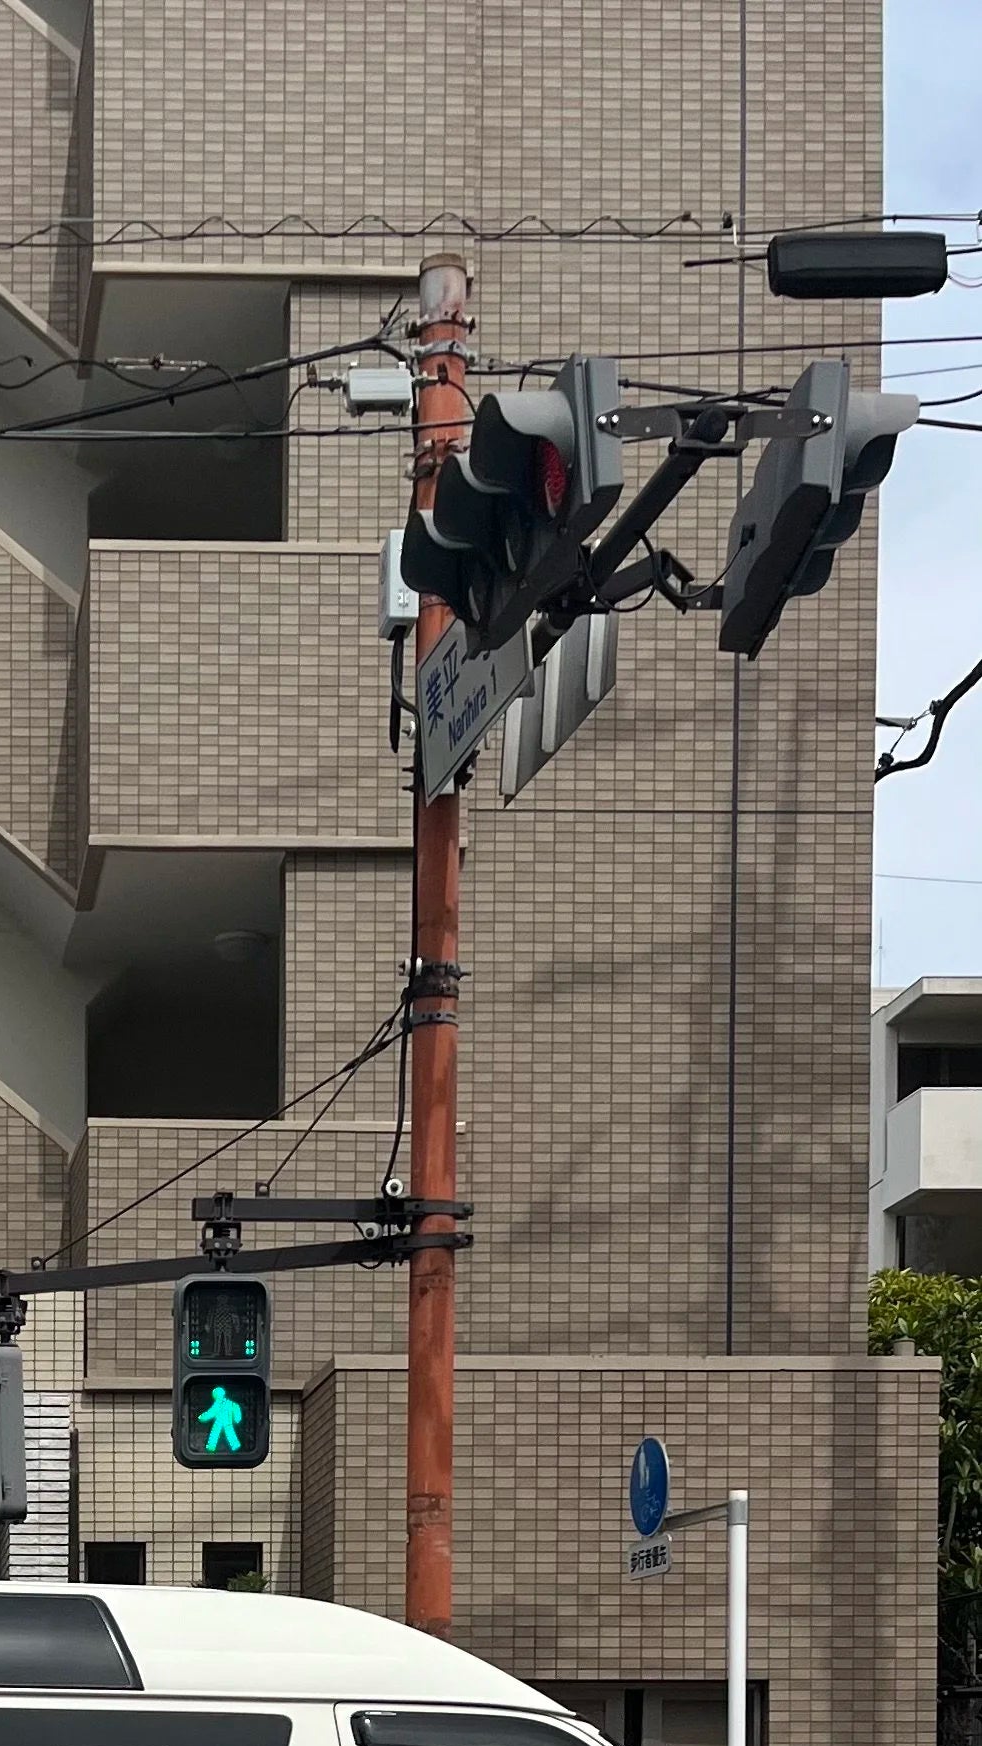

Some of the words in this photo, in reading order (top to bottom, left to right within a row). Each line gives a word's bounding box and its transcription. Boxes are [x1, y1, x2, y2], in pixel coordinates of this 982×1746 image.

[425, 641, 491, 738] 業平
[449, 685, 487, 752] Narihira
[490, 663, 497, 695] 1
